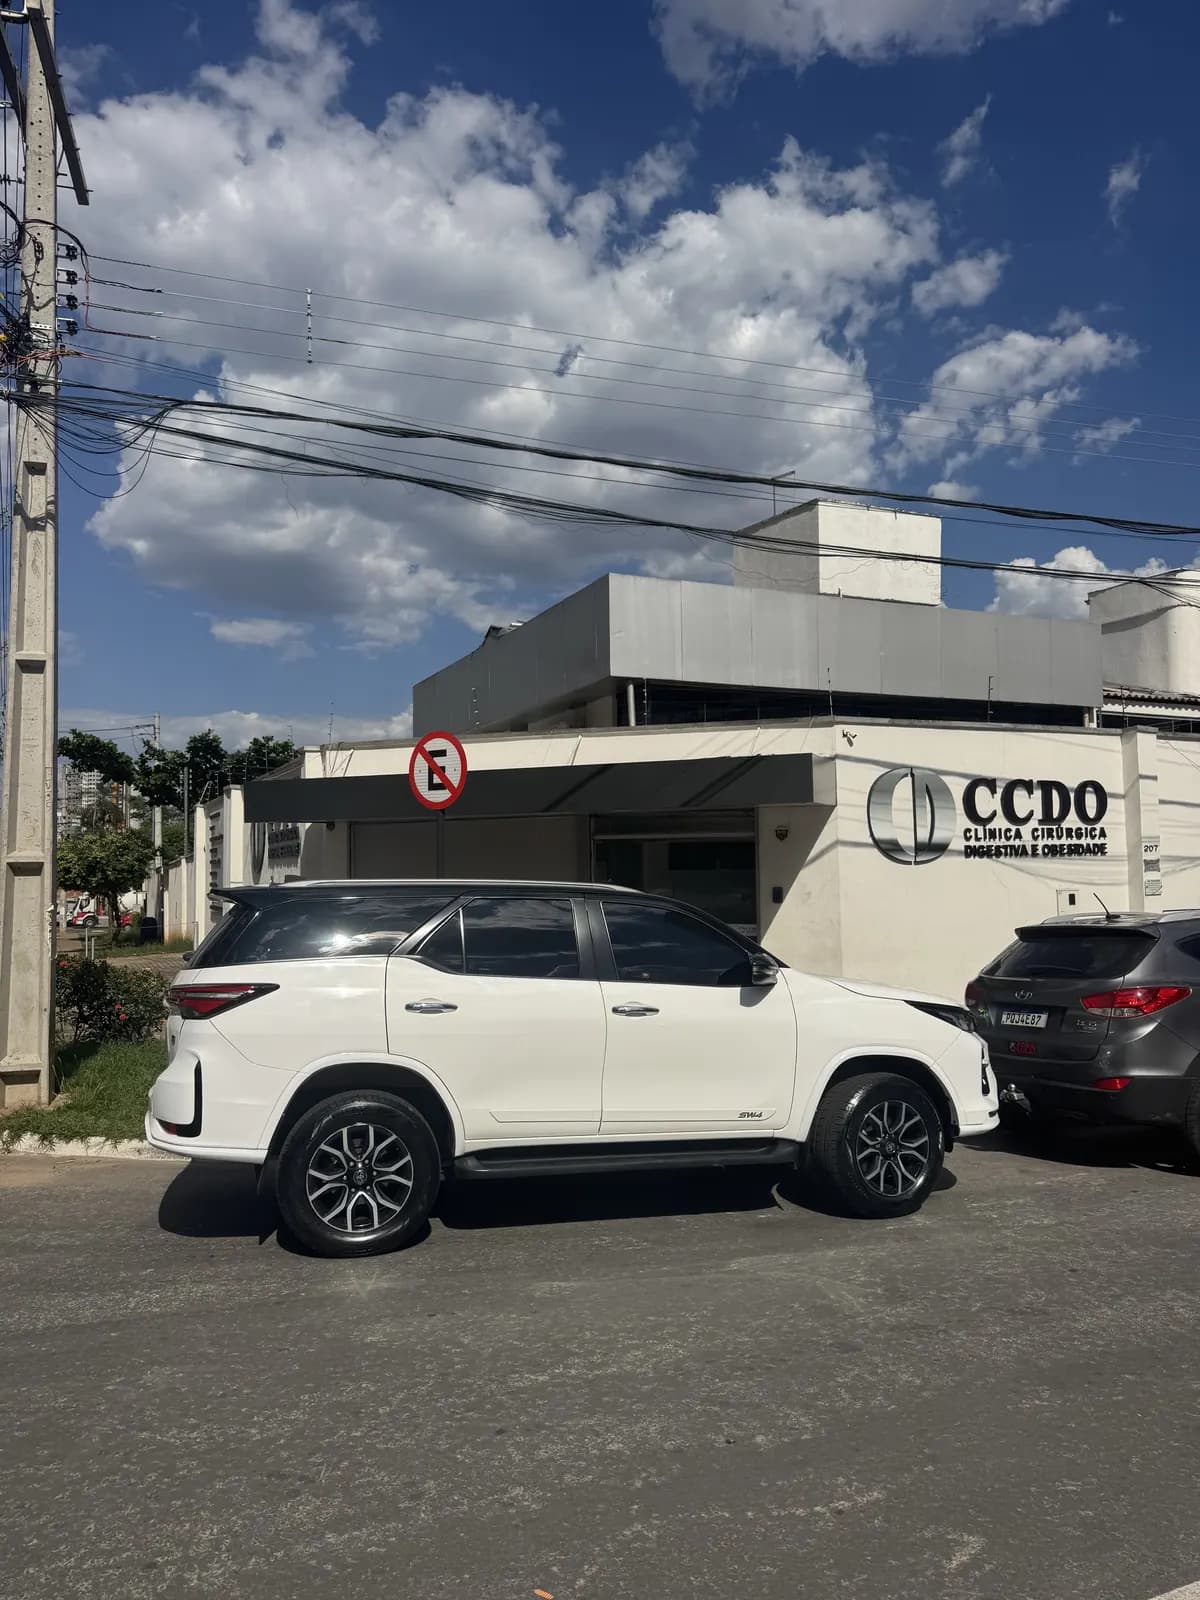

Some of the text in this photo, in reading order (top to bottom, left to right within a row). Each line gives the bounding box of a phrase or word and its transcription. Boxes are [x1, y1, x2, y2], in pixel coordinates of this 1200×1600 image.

[962, 777, 1108, 826] CCDO
[1031, 824, 1107, 841] CIRÚRGICA
[964, 843, 1108, 859] DIGESTIVA E OBESIDADE
[1143, 844, 1159, 853] 207
